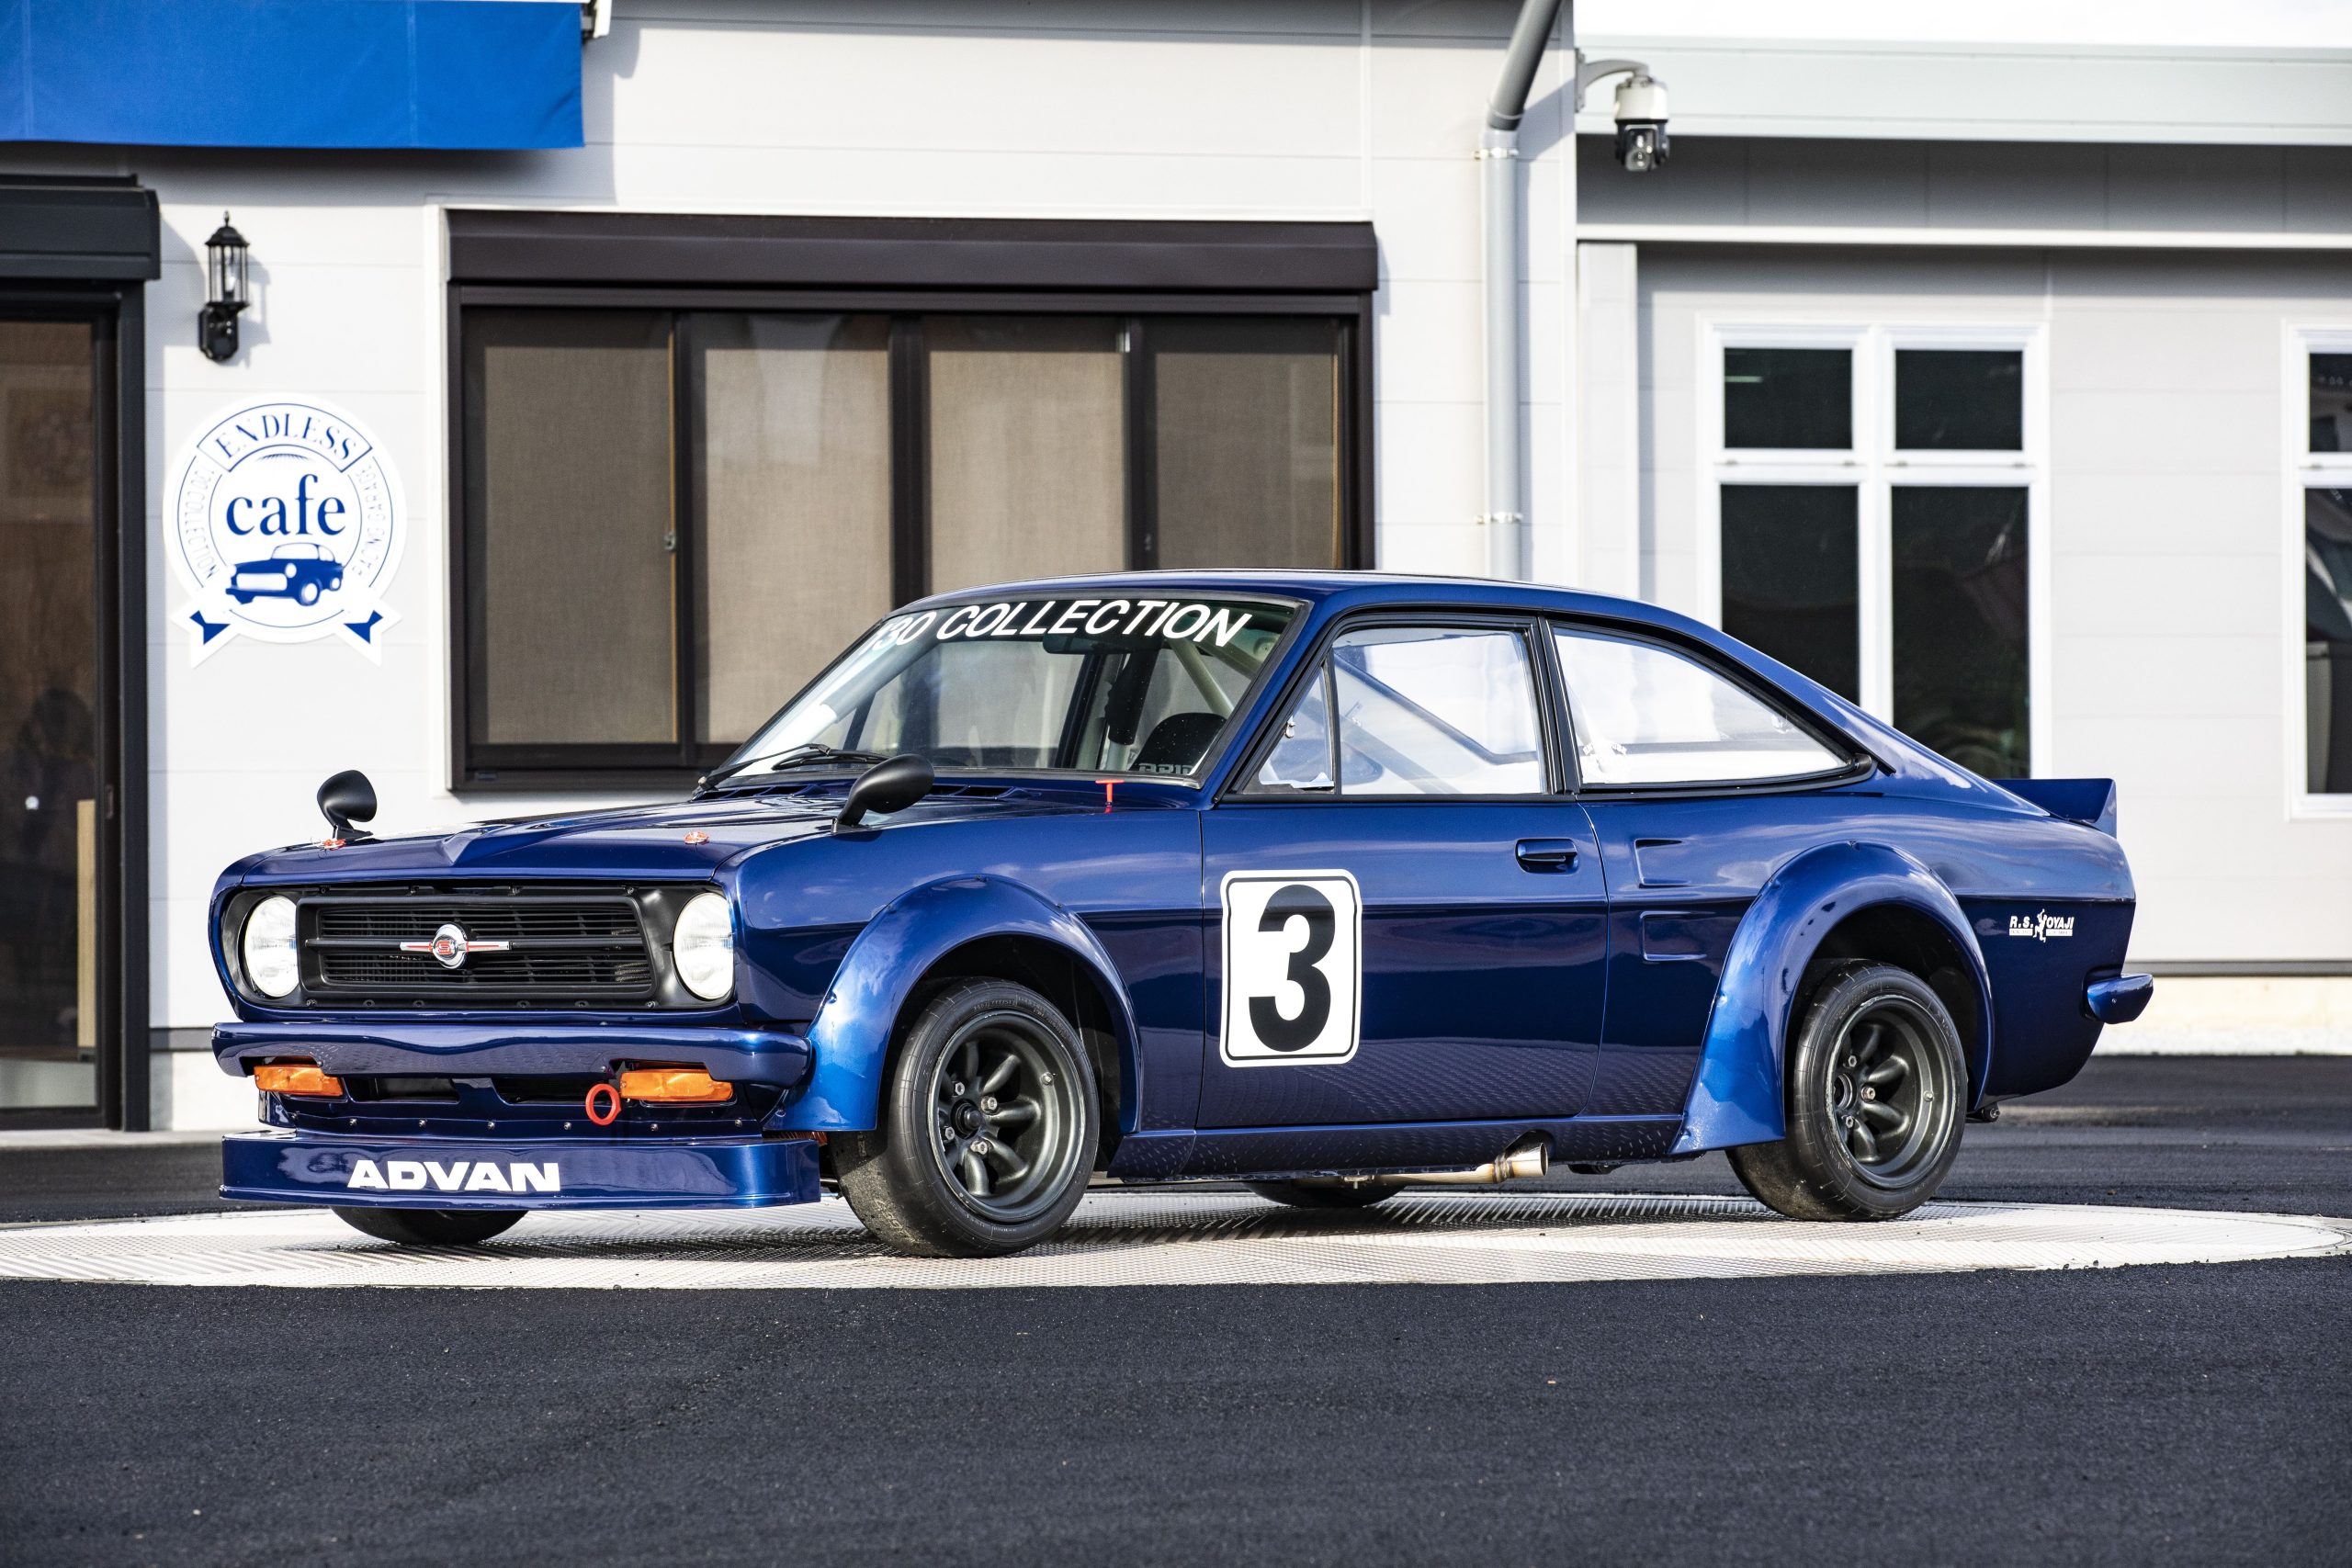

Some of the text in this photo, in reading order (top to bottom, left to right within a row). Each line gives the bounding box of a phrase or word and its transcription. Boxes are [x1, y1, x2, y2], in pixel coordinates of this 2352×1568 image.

[214, 413, 356, 460] ENDLESS
[226, 473, 346, 536] cafe
[936, 599, 1252, 647] COLLECTION
[2009, 915, 2033, 928] R.S.
[1249, 884, 1336, 1053] 3
[346, 1159, 560, 1192] ADVAN
